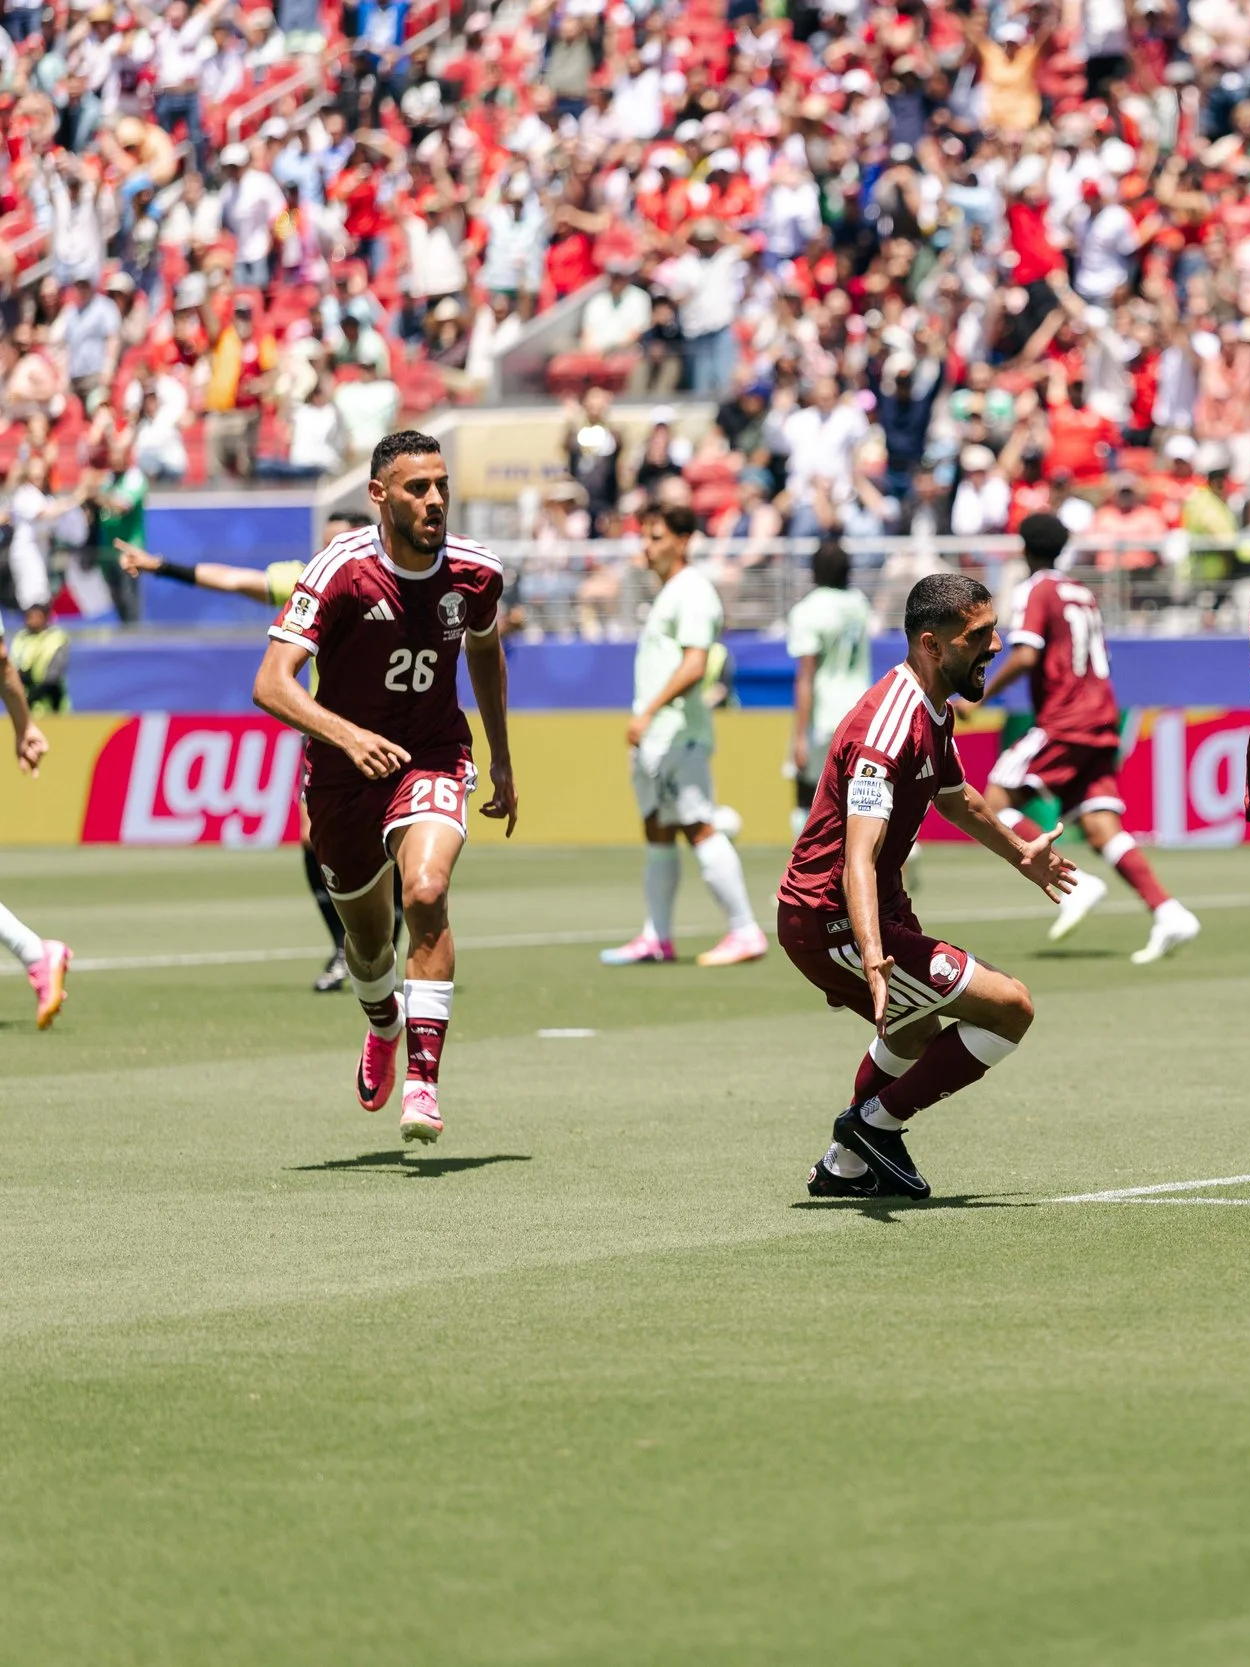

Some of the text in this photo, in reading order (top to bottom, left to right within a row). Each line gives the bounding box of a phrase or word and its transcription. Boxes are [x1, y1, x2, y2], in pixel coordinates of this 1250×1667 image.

[384, 648, 438, 693] 26
[410, 776, 460, 813] 26
[852, 787, 882, 798] UNITES
